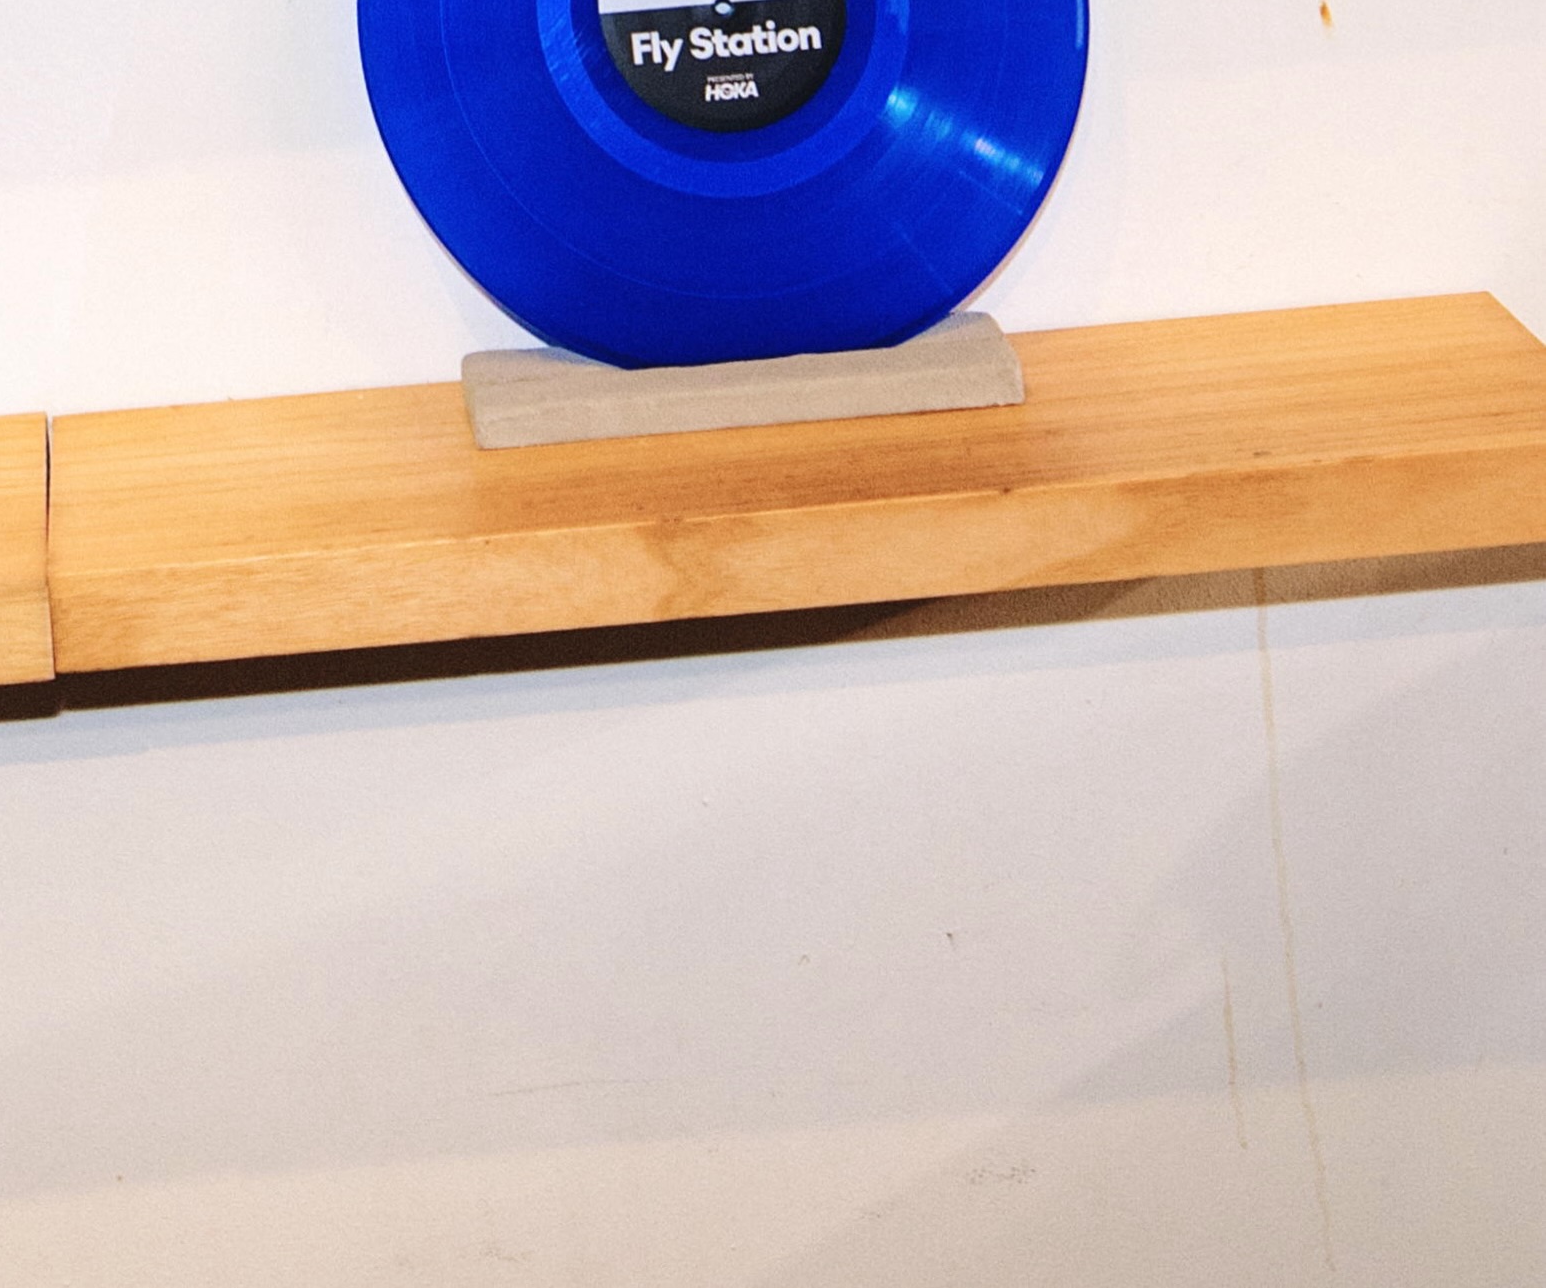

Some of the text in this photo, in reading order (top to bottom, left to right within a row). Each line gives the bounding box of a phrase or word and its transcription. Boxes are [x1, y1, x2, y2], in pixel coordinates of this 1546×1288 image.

[631, 20, 822, 72] Fly Station
[705, 80, 760, 102] HOKA
